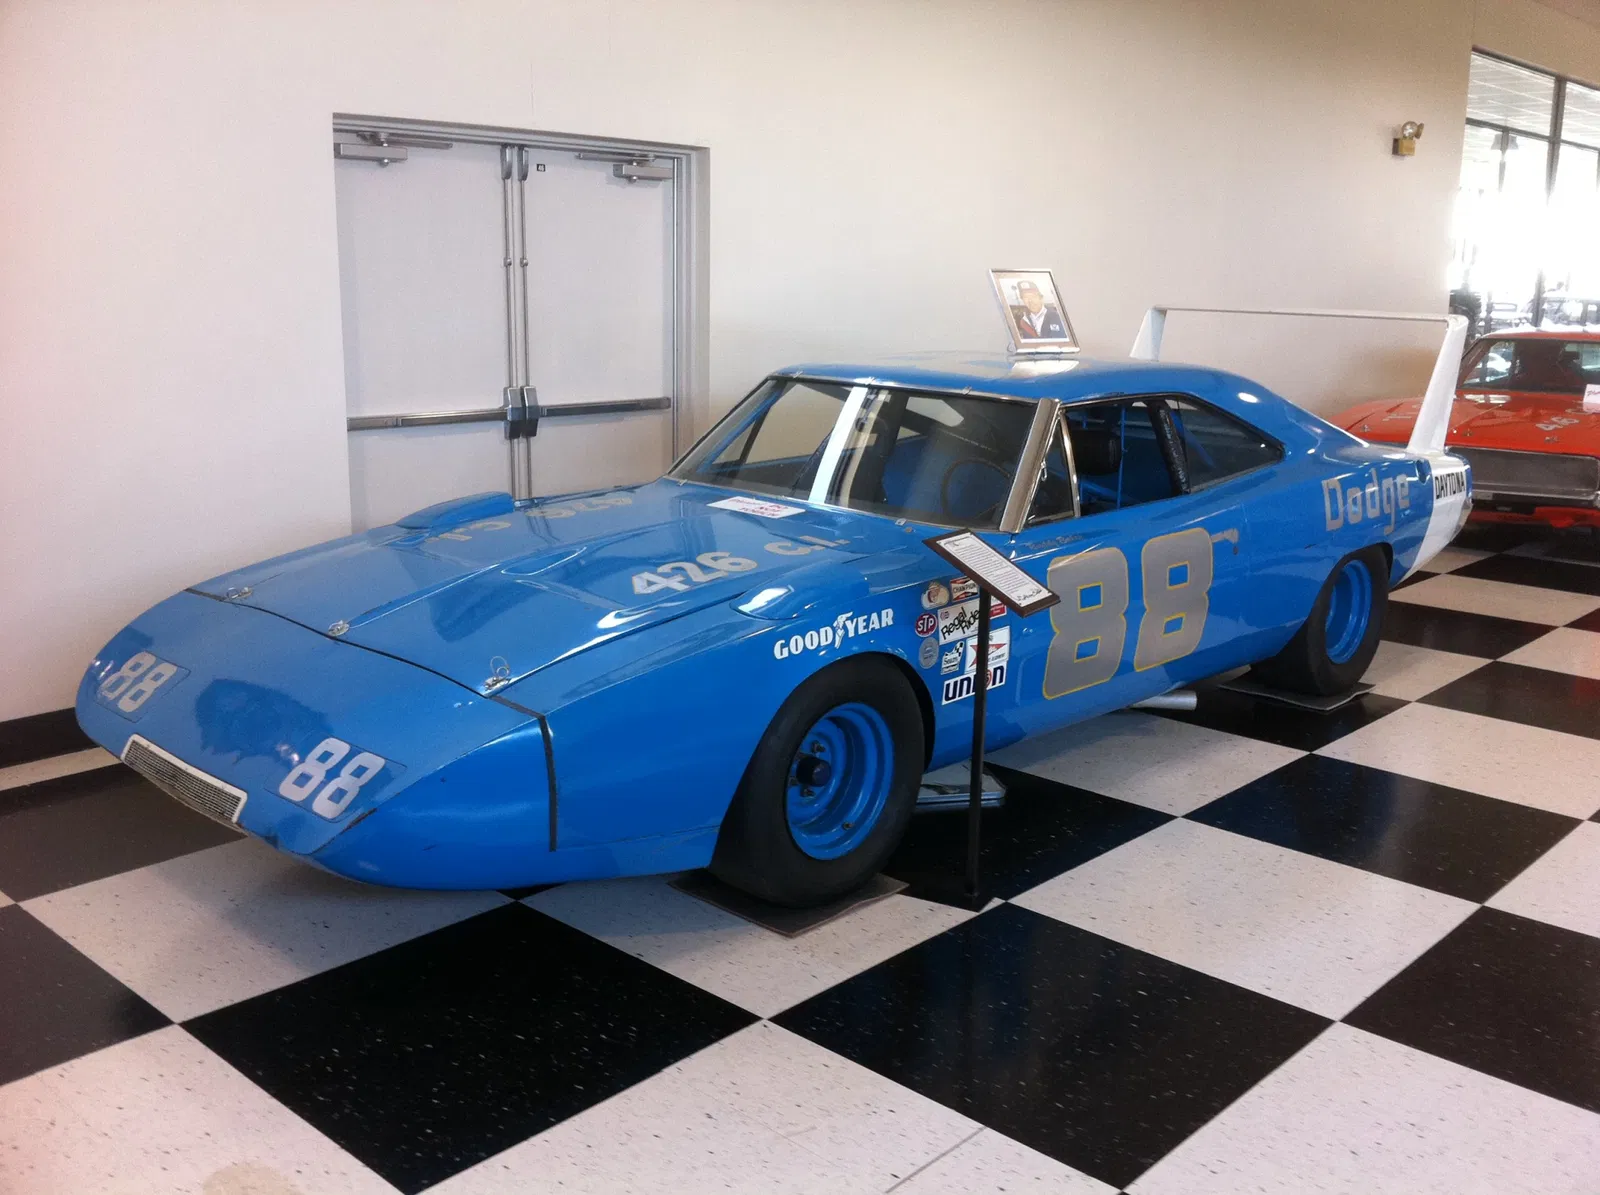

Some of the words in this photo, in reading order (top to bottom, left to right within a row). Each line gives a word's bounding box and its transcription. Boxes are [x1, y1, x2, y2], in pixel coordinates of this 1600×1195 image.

[1321, 468, 1410, 535] Dodge
[1434, 469, 1467, 501] DAYTONA
[631, 551, 759, 596] 426
[952, 582, 978, 594] CHAMPION
[773, 608, 894, 660] GOODYEAR
[917, 614, 936, 633] STP
[941, 606, 967, 640] Regal
[1042, 527, 1213, 700] 88
[98, 651, 178, 713] 88
[279, 737, 386, 820] 88
